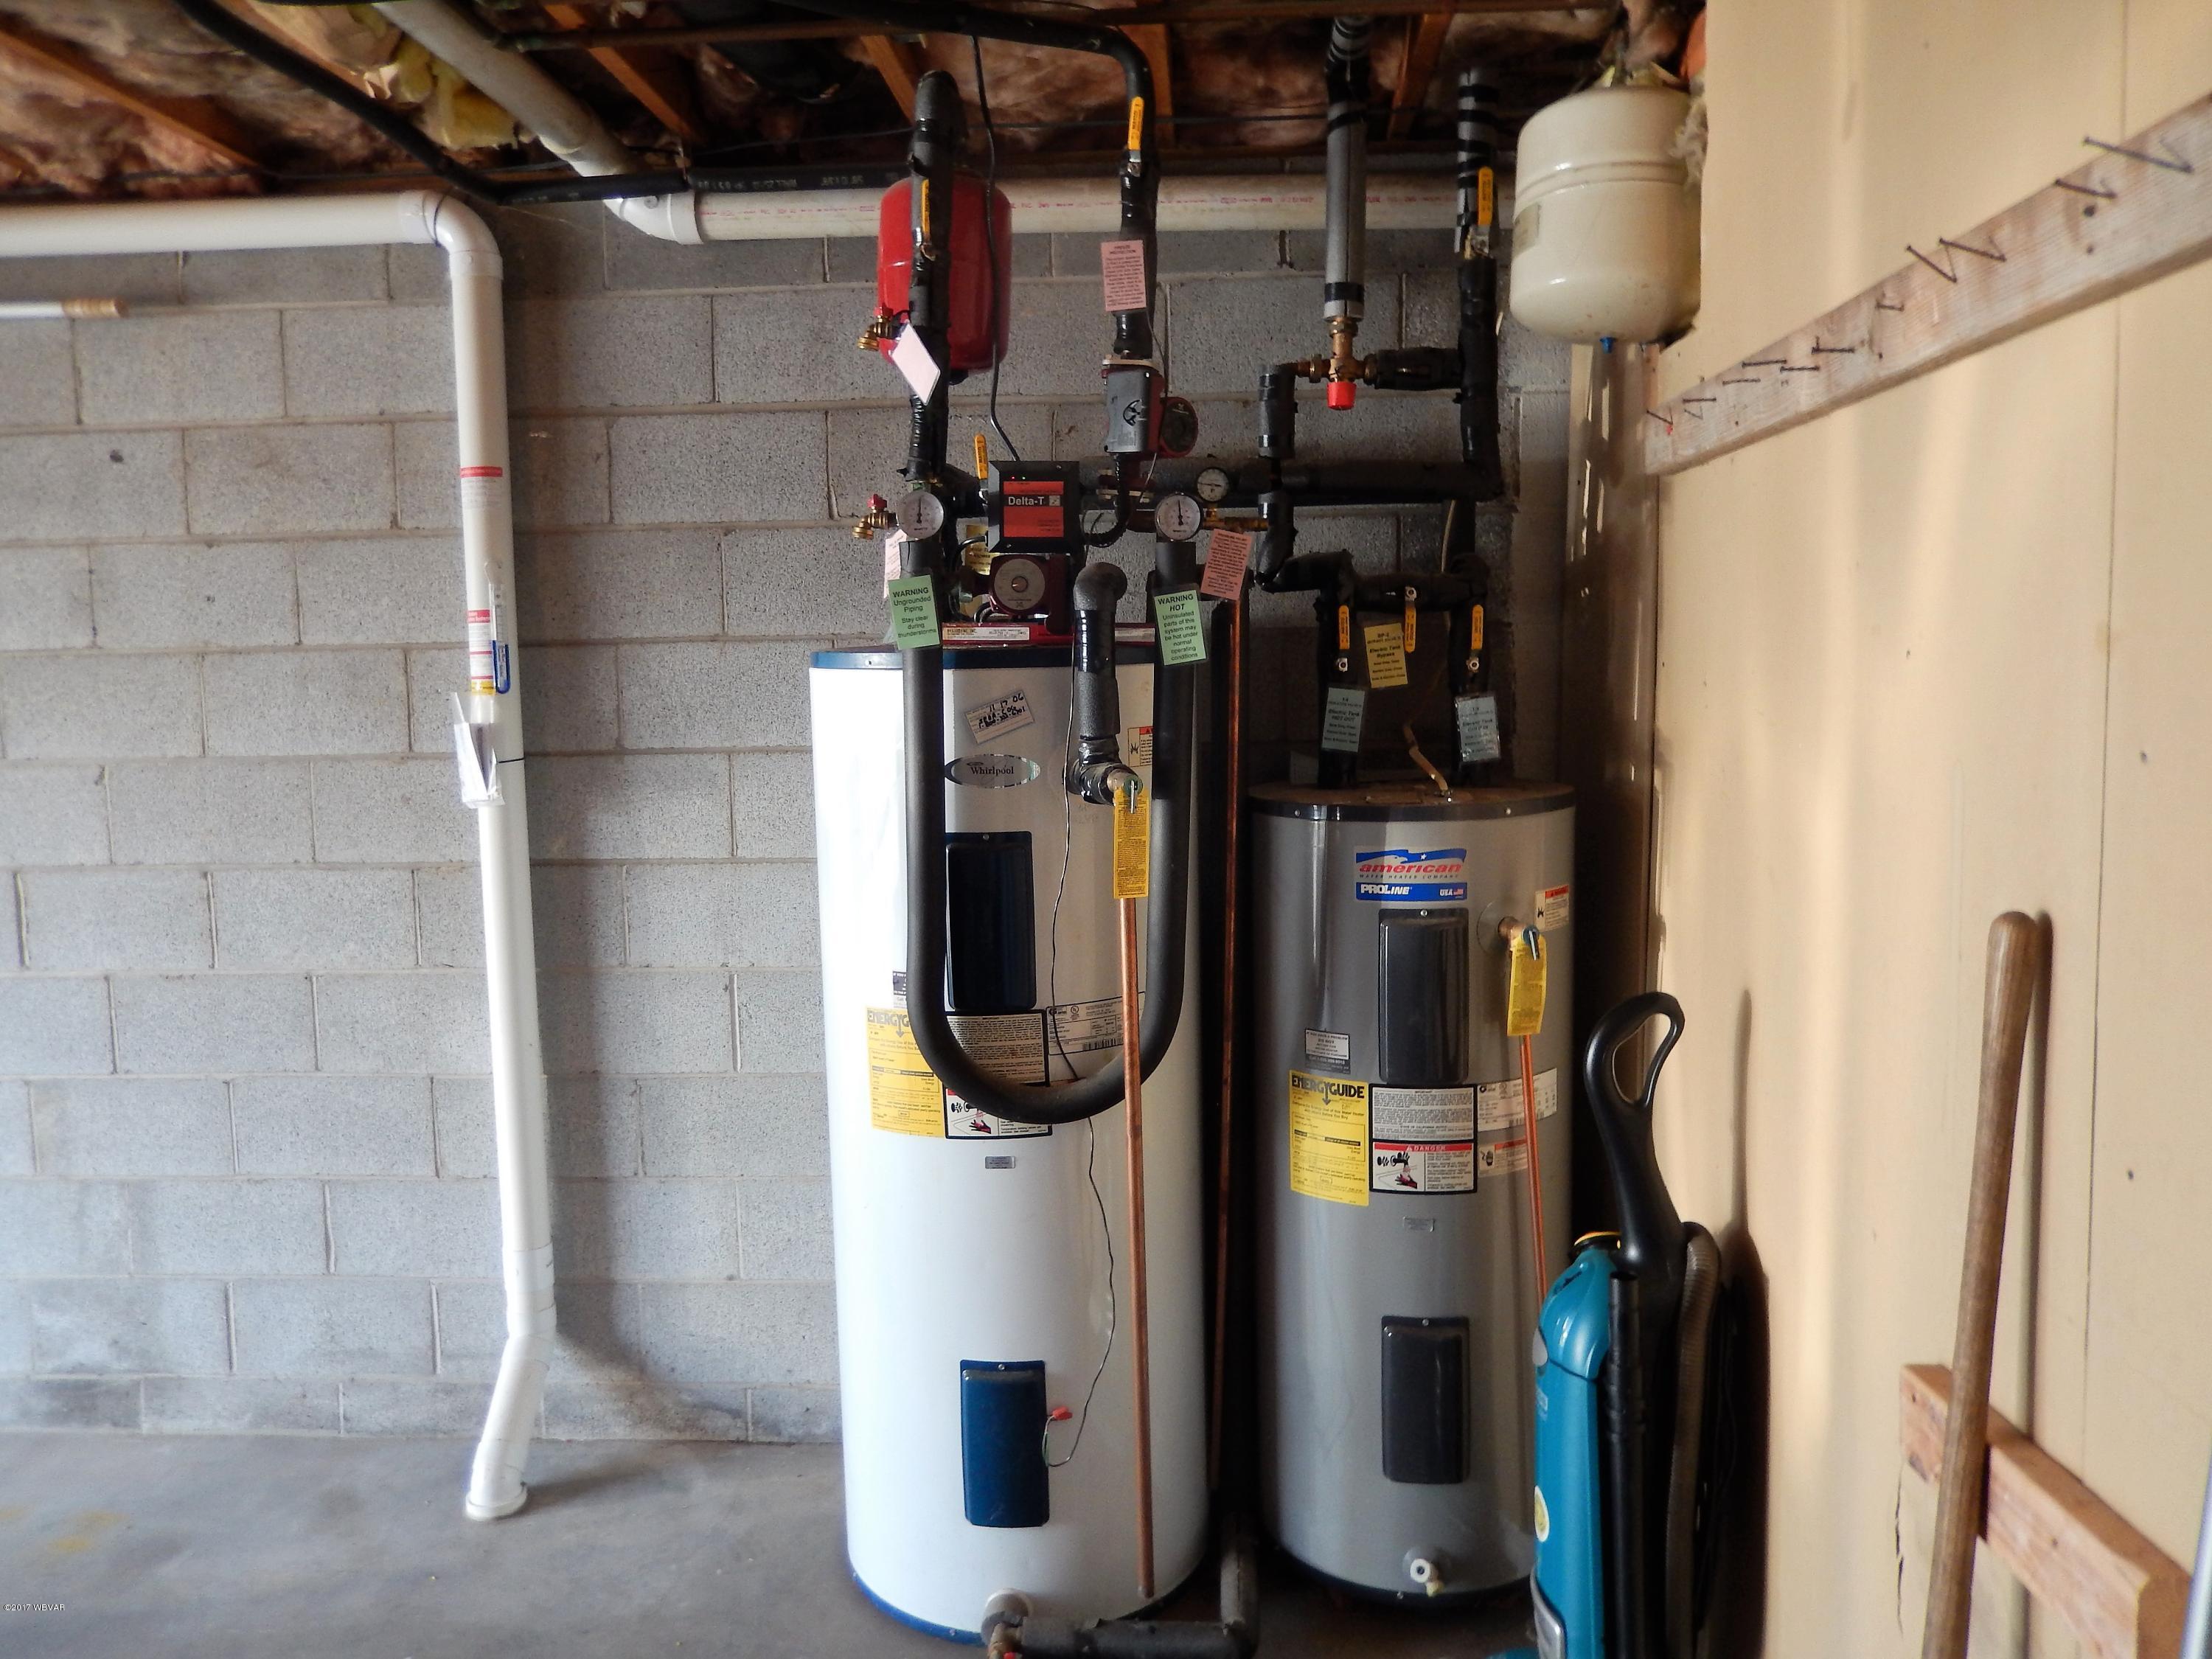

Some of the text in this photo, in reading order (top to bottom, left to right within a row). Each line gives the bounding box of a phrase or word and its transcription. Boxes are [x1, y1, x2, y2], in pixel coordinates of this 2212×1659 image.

[1008, 496, 1044, 506] Delta-T
[892, 587, 929, 598] WARNING
[893, 596, 931, 606] Ungrounded
[1158, 594, 1194, 605] WARNING
[1169, 603, 1185, 612] HOT
[1162, 611, 1194, 620] Uninsulated
[897, 629, 936, 638] thunderstorms
[1164, 627, 1184, 635] system
[1012, 693, 1024, 703] 06
[970, 765, 1014, 776] Whirlpool
[1359, 863, 1461, 874] american
[1360, 884, 1453, 897] PROLINE USA
[1292, 1074, 1365, 1099] ENERGYGUIDE
[1413, 1144, 1447, 1152] DANGER
